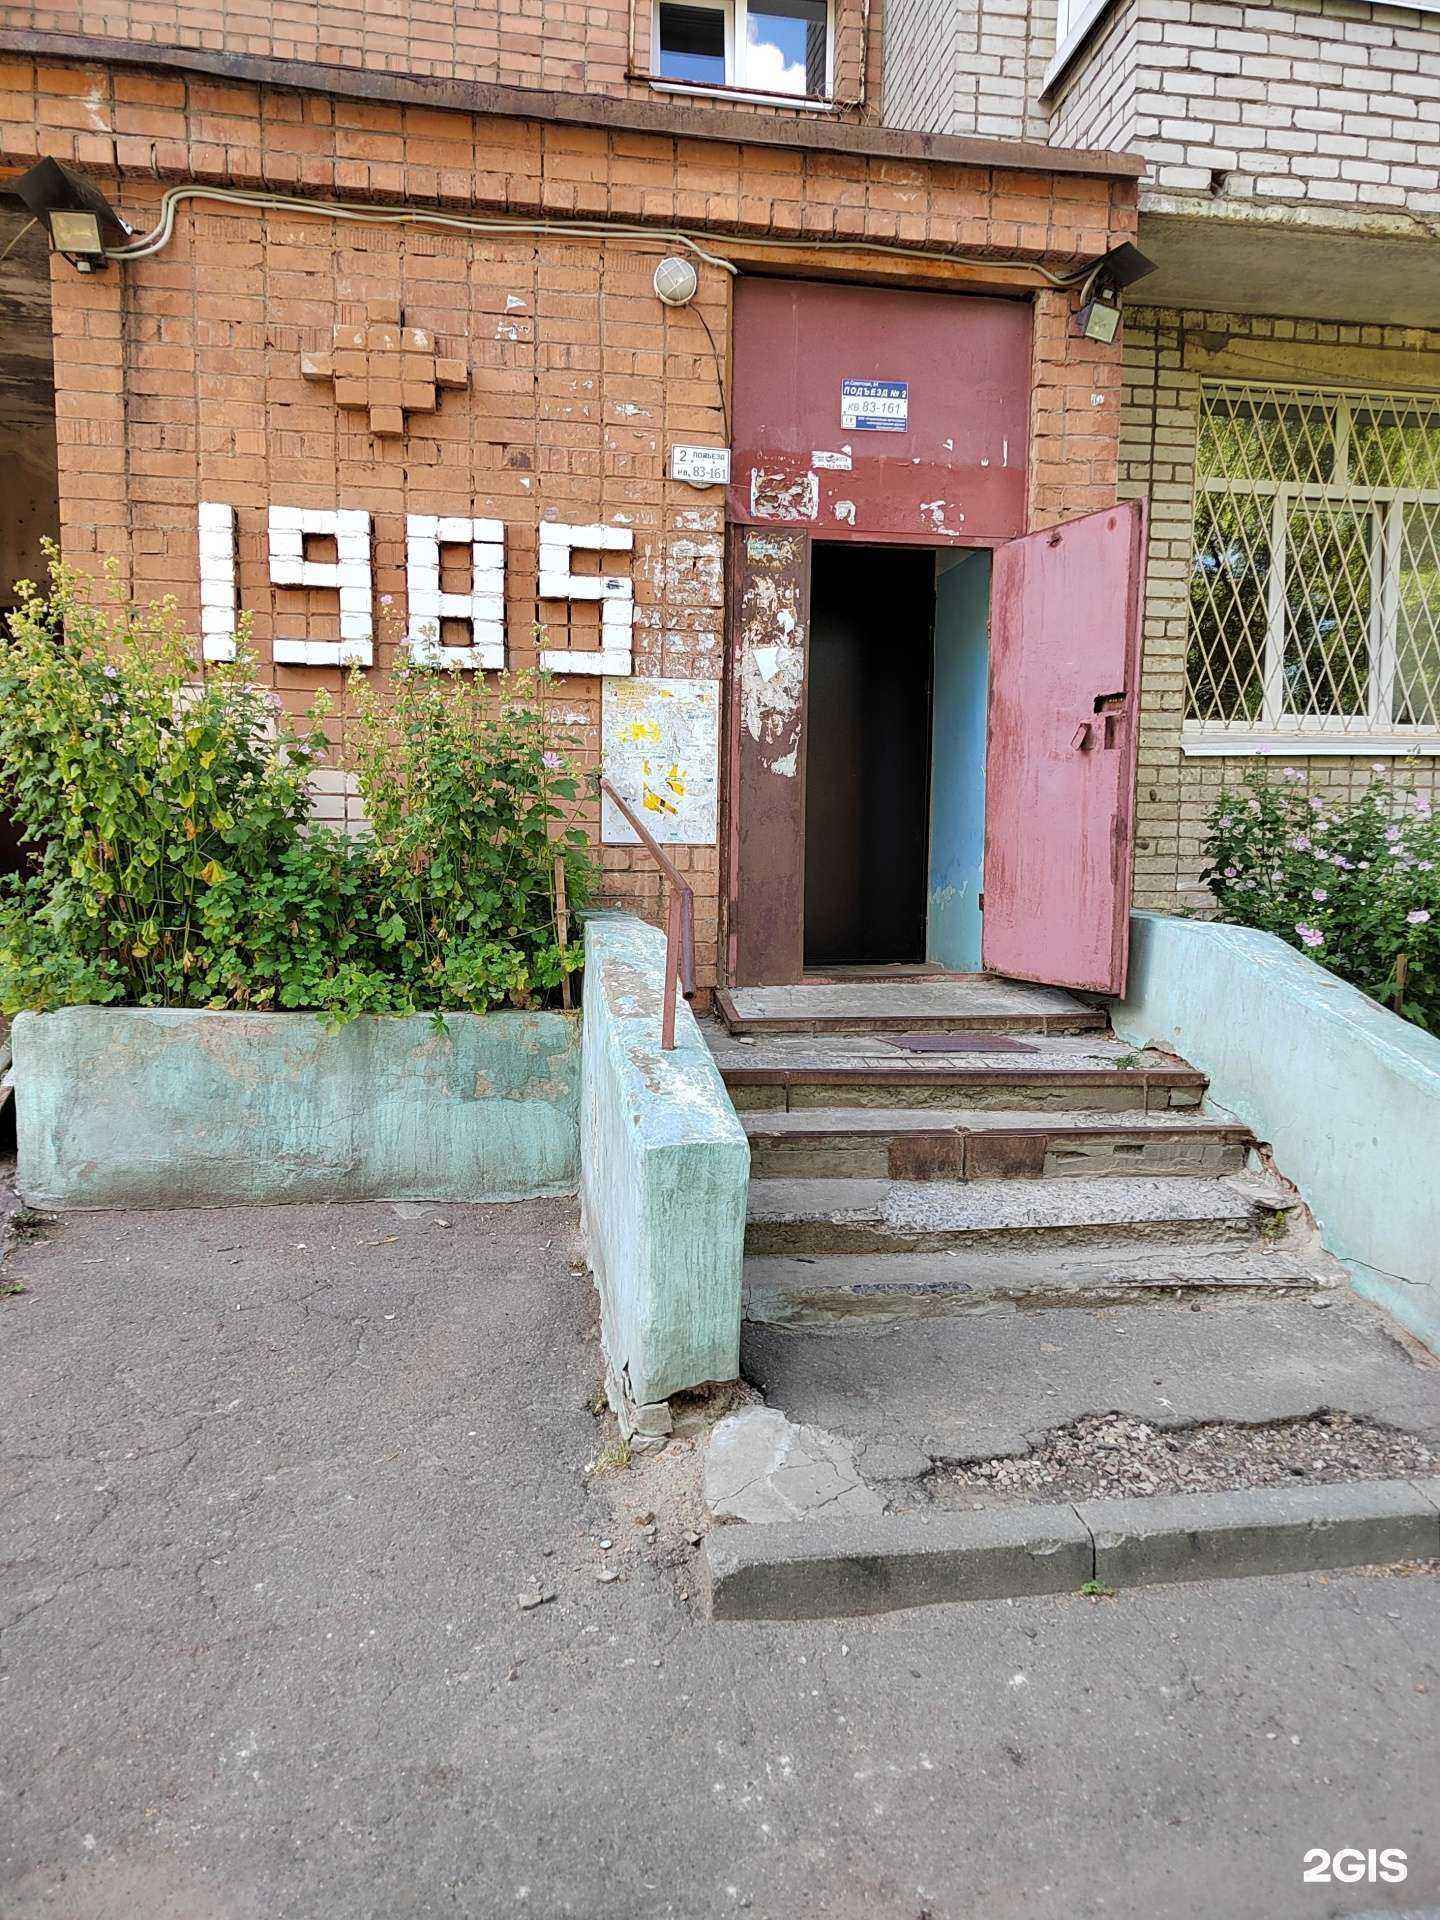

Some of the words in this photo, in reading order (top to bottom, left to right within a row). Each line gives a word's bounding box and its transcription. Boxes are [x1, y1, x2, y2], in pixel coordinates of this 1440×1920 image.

[844, 386, 887, 398] ПОДЪЕЗД
[901, 390, 907, 398] 2
[862, 401, 901, 415] 83-161
[692, 466, 727, 480] 83-161
[198, 501, 634, 676] 1985
